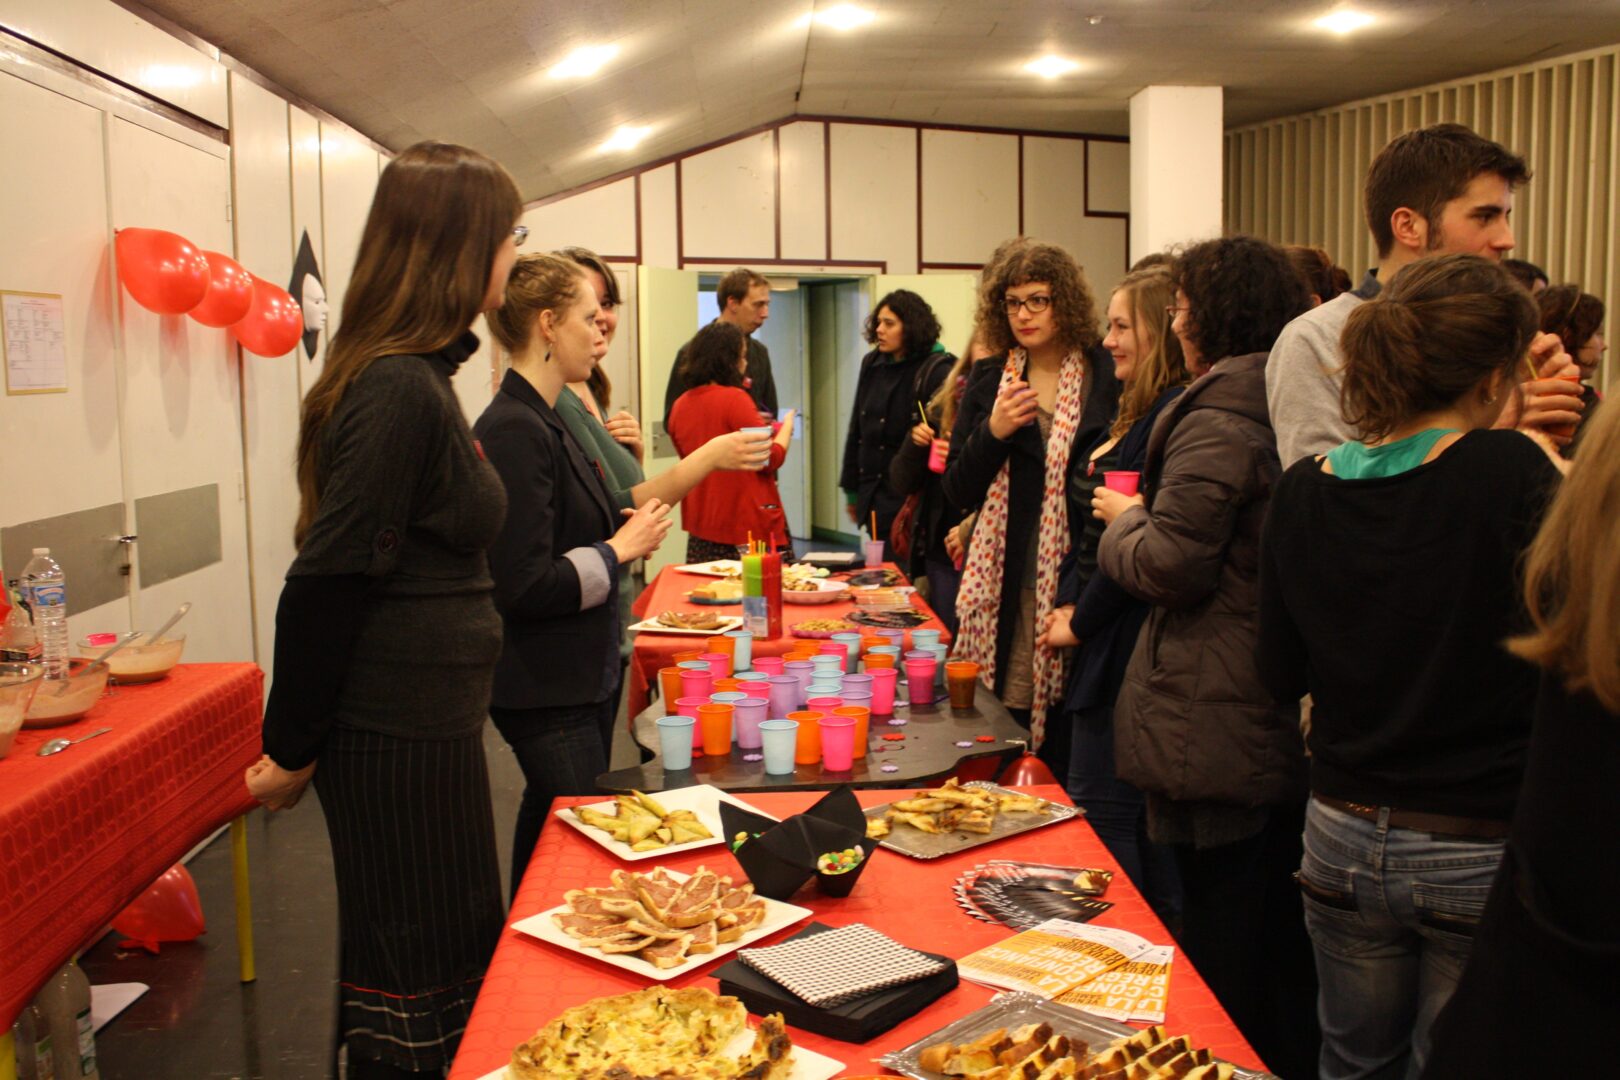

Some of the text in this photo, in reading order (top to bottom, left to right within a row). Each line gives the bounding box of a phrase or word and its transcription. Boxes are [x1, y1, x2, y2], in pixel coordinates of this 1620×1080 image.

[978, 946, 1087, 982] CONFIANCE
[1036, 974, 1070, 993] LA
[1104, 994, 1135, 1010] LA
